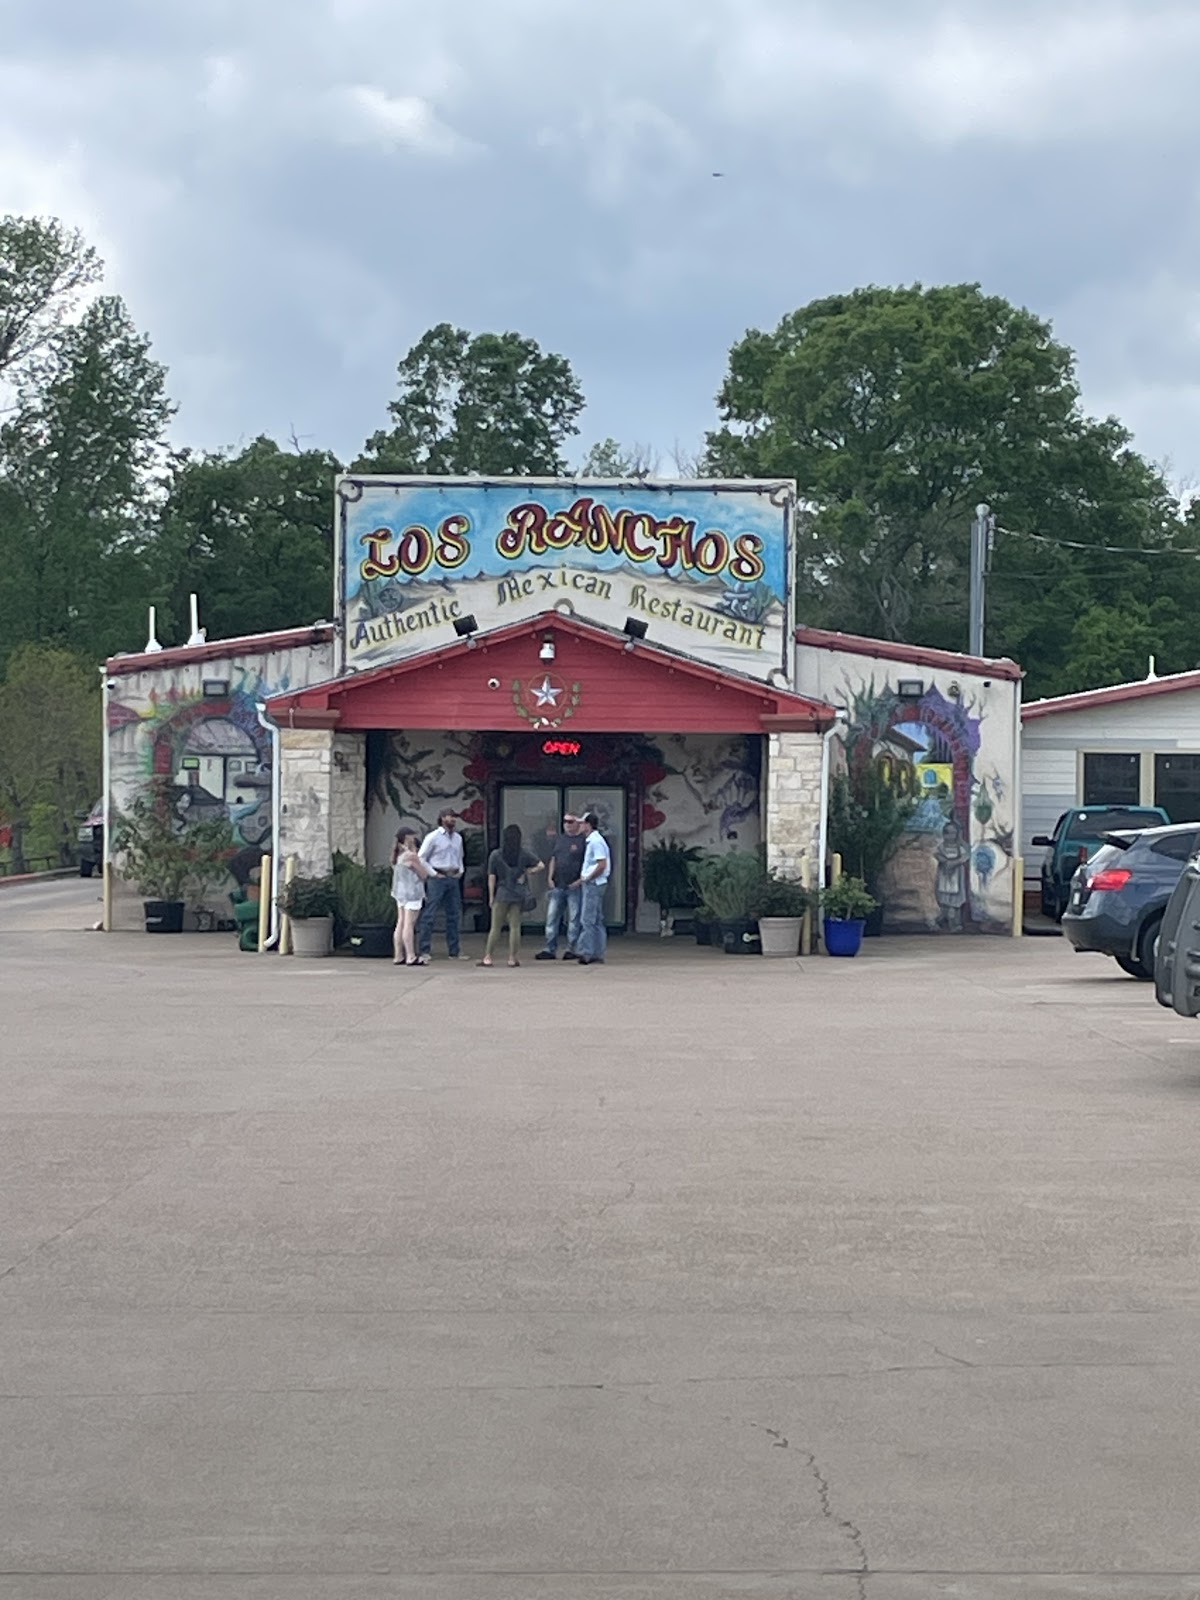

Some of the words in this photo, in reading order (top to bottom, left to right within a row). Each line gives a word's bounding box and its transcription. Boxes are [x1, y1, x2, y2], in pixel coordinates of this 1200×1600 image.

[360, 515, 471, 580] LOS
[496, 498, 765, 581] RANCHOS
[350, 599, 462, 649] Authentic
[497, 565, 612, 605] Mexican
[629, 584, 766, 649] Restaurant
[543, 740, 581, 755] OPEN
